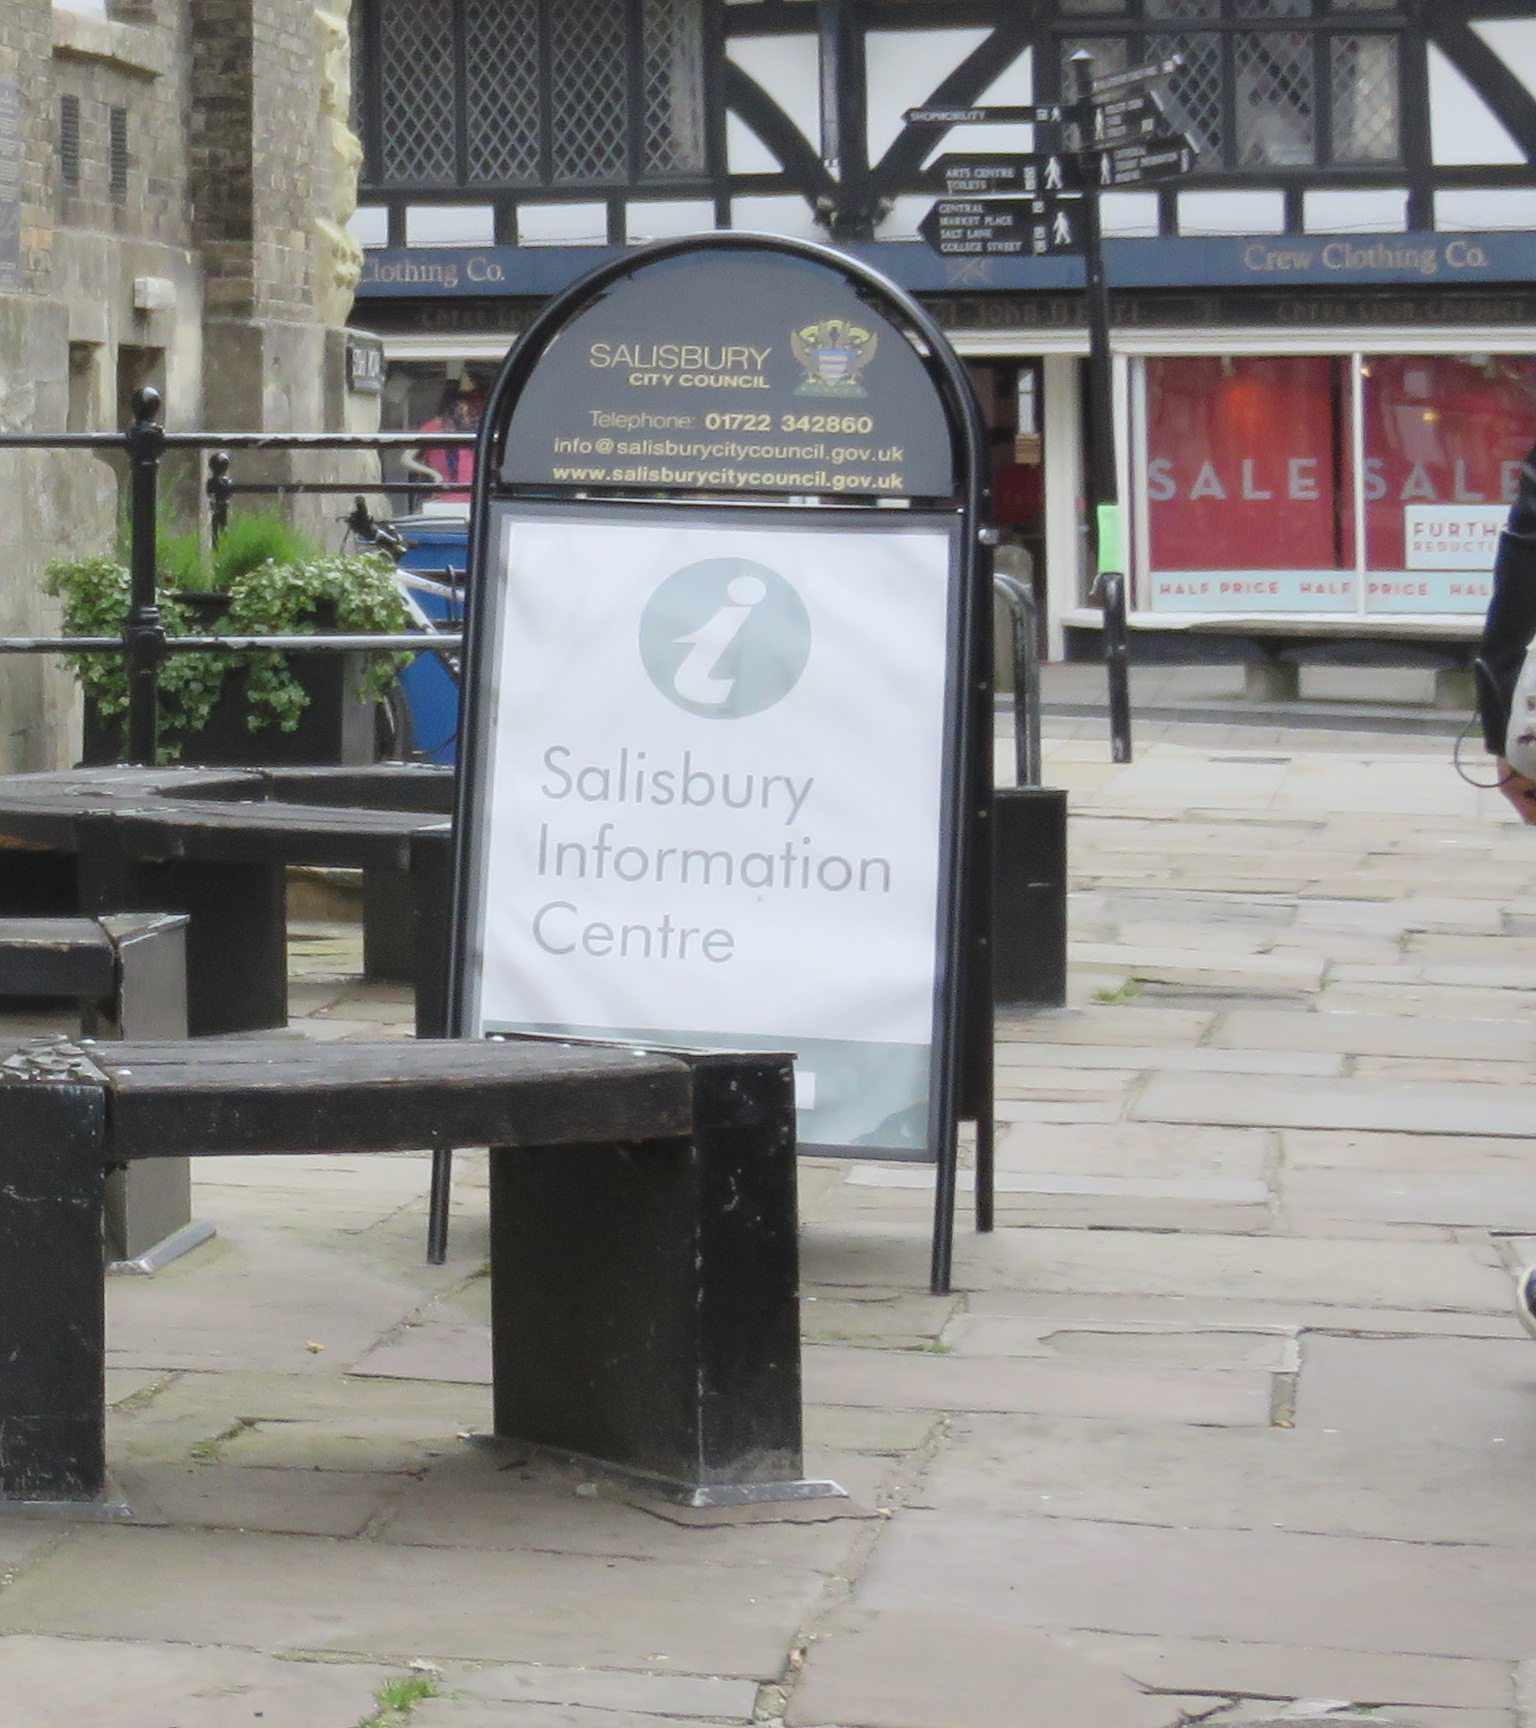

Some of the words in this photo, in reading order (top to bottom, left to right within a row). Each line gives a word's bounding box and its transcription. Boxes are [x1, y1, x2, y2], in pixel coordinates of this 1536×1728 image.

[945, 168, 971, 178] ARTS
[974, 168, 1014, 178] CENTRE
[939, 216, 981, 226] MARKET
[984, 216, 1014, 226] PLACE
[940, 242, 983, 252] COLLEGE
[987, 242, 1022, 252] STREET
[1243, 243, 1313, 271] Crew
[1322, 242, 1438, 275] Clothing
[466, 256, 505, 282] Co.
[589, 343, 772, 371] SALISBURY
[628, 373, 676, 387] CITY
[679, 373, 770, 389] COUNCIL
[589, 410, 695, 431] Telephone:
[705, 412, 772, 432] 01722
[780, 415, 874, 434] 342860
[553, 465, 903, 491] www.salisburycitycouncil.gov.uk
[1148, 458, 1321, 501] SALE
[1413, 522, 1497, 537] FURTH
[1413, 541, 1493, 552] REDUCTI
[1159, 582, 1210, 595] HALF
[1219, 582, 1279, 595] PRICE
[1300, 582, 1351, 595] HALF
[1368, 582, 1428, 596] PRICE
[1450, 583, 1489, 596] HAL
[541, 745, 815, 826] Salisbury
[537, 822, 892, 893] Information
[532, 900, 736, 964] Centre
